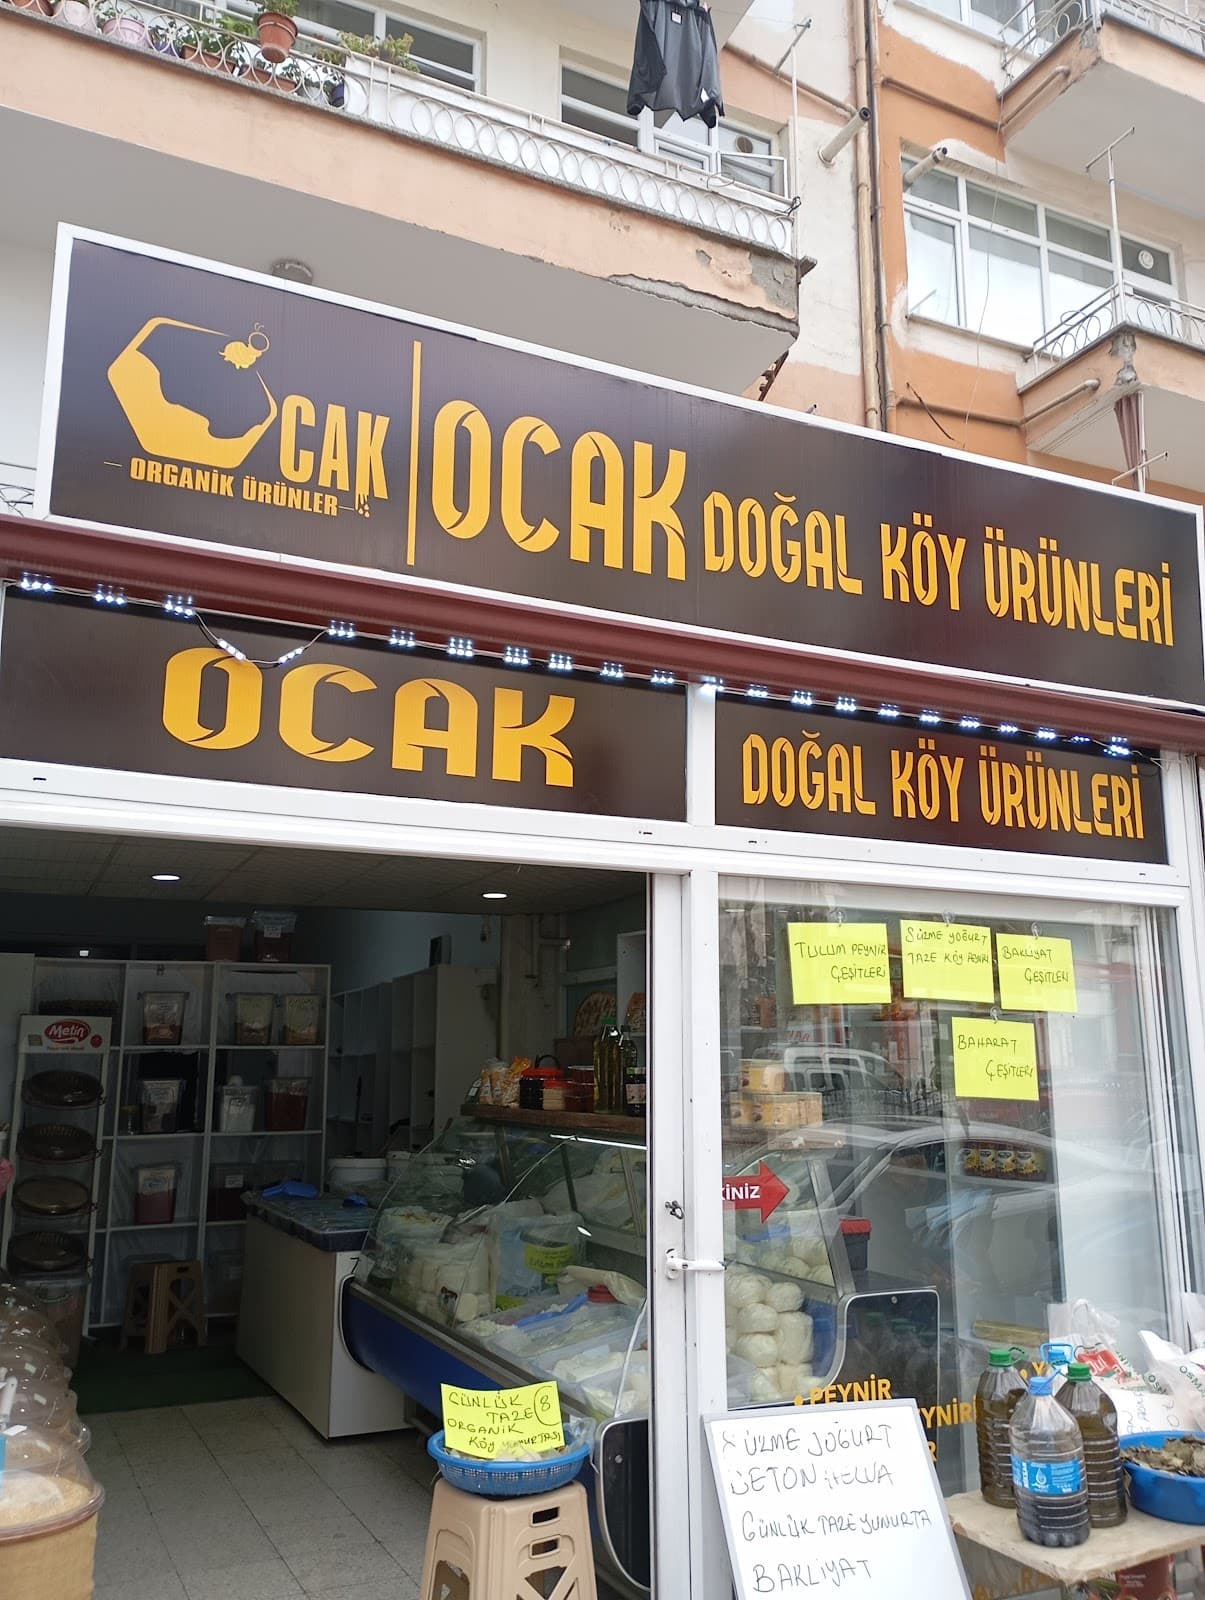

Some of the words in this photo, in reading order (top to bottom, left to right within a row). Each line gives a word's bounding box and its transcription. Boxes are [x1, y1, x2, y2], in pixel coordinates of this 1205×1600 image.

[130, 457, 235, 498] ORGANİK
[242, 475, 338, 517] ÜRÜNLER
[431, 399, 687, 582] OCAK
[702, 490, 863, 595] DOĞAL
[879, 511, 966, 611] KÖY
[982, 526, 1174, 647] ÜRÜNLERİ
[162, 646, 576, 788] OCAK
[741, 729, 876, 816] DOĞAL
[890, 737, 964, 823] KÖY
[978, 742, 1145, 840] ÜRÜNLERİ
[794, 941, 846, 959] TULUM
[48, 1023, 85, 1038] Metin
[957, 1034, 1018, 1056] BAHARAT
[809, 1373, 892, 1406] PEYNİR
[447, 1418, 524, 1435] ORGANİK
